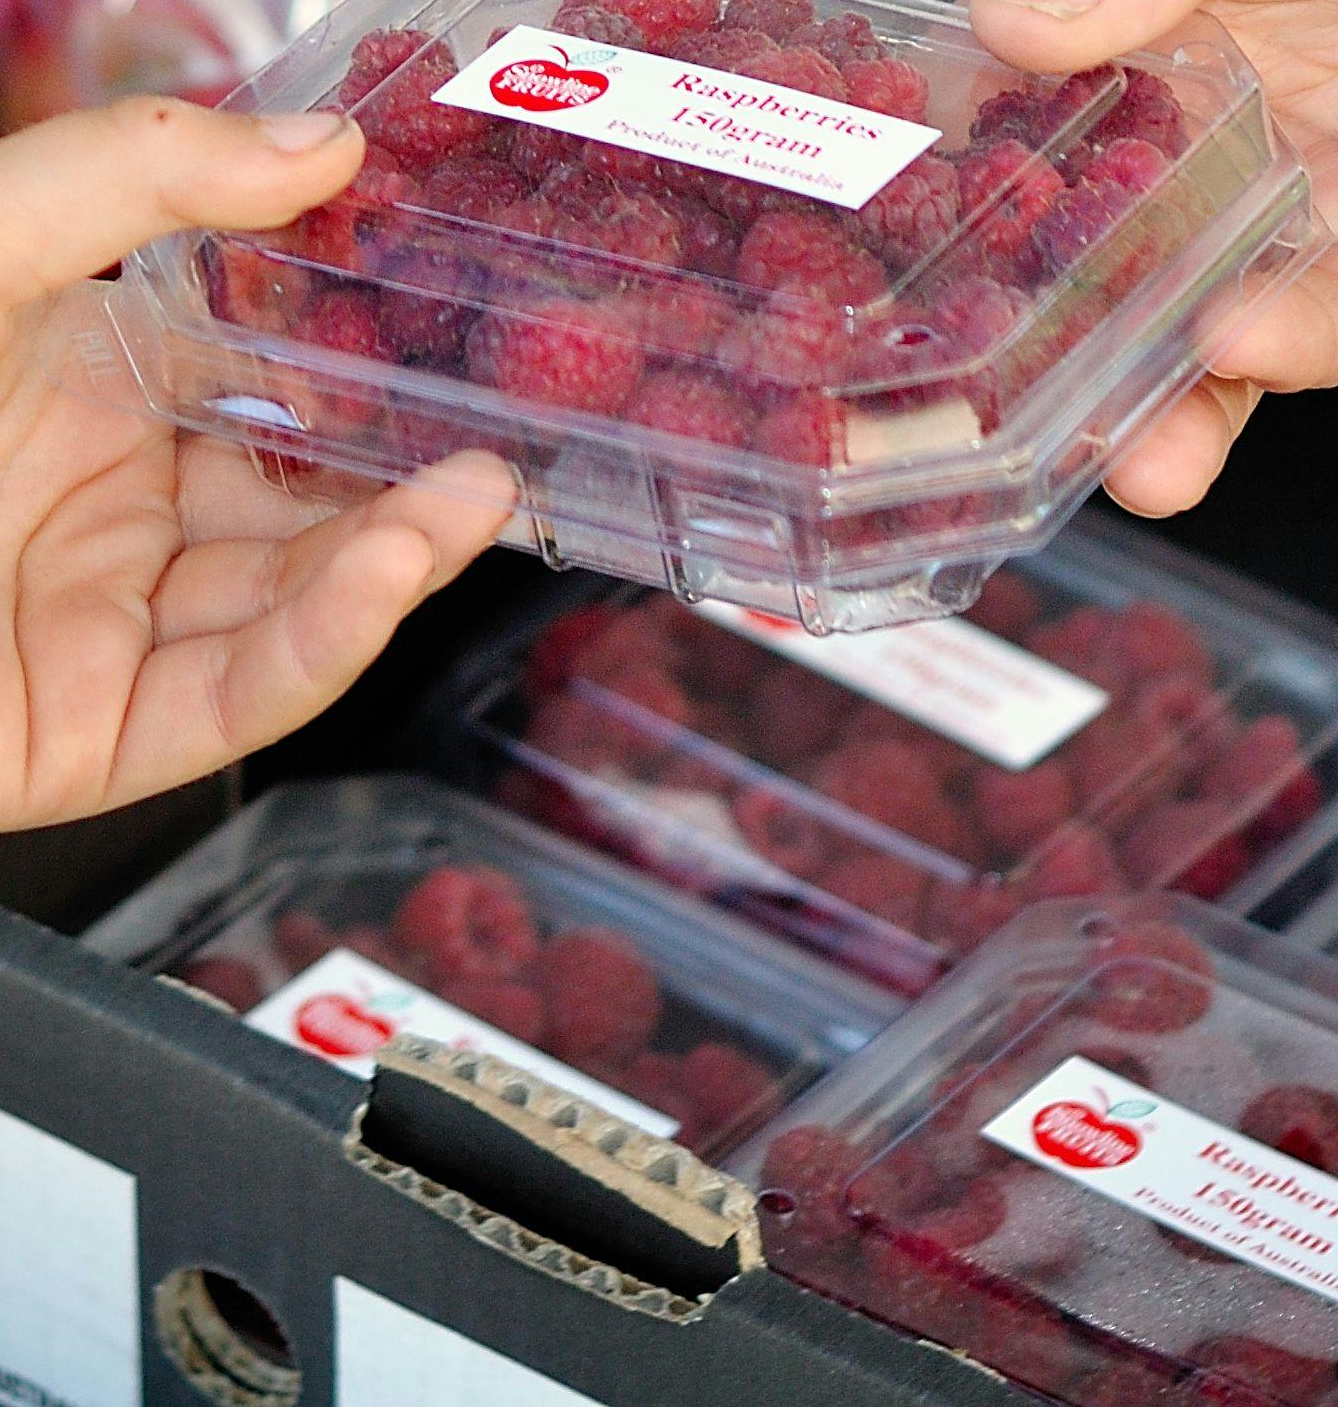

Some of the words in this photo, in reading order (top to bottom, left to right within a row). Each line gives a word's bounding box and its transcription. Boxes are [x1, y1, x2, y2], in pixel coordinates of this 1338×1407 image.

[672, 73, 882, 139] Raspberries
[672, 107, 821, 158] 150gram
[607, 119, 700, 151] Product
[706, 147, 735, 159] of
[736, 153, 844, 191] Australia
[1133, 1185, 1219, 1235] Product
[1222, 1229, 1249, 1246] of
[1192, 1180, 1335, 1256] 150gram
